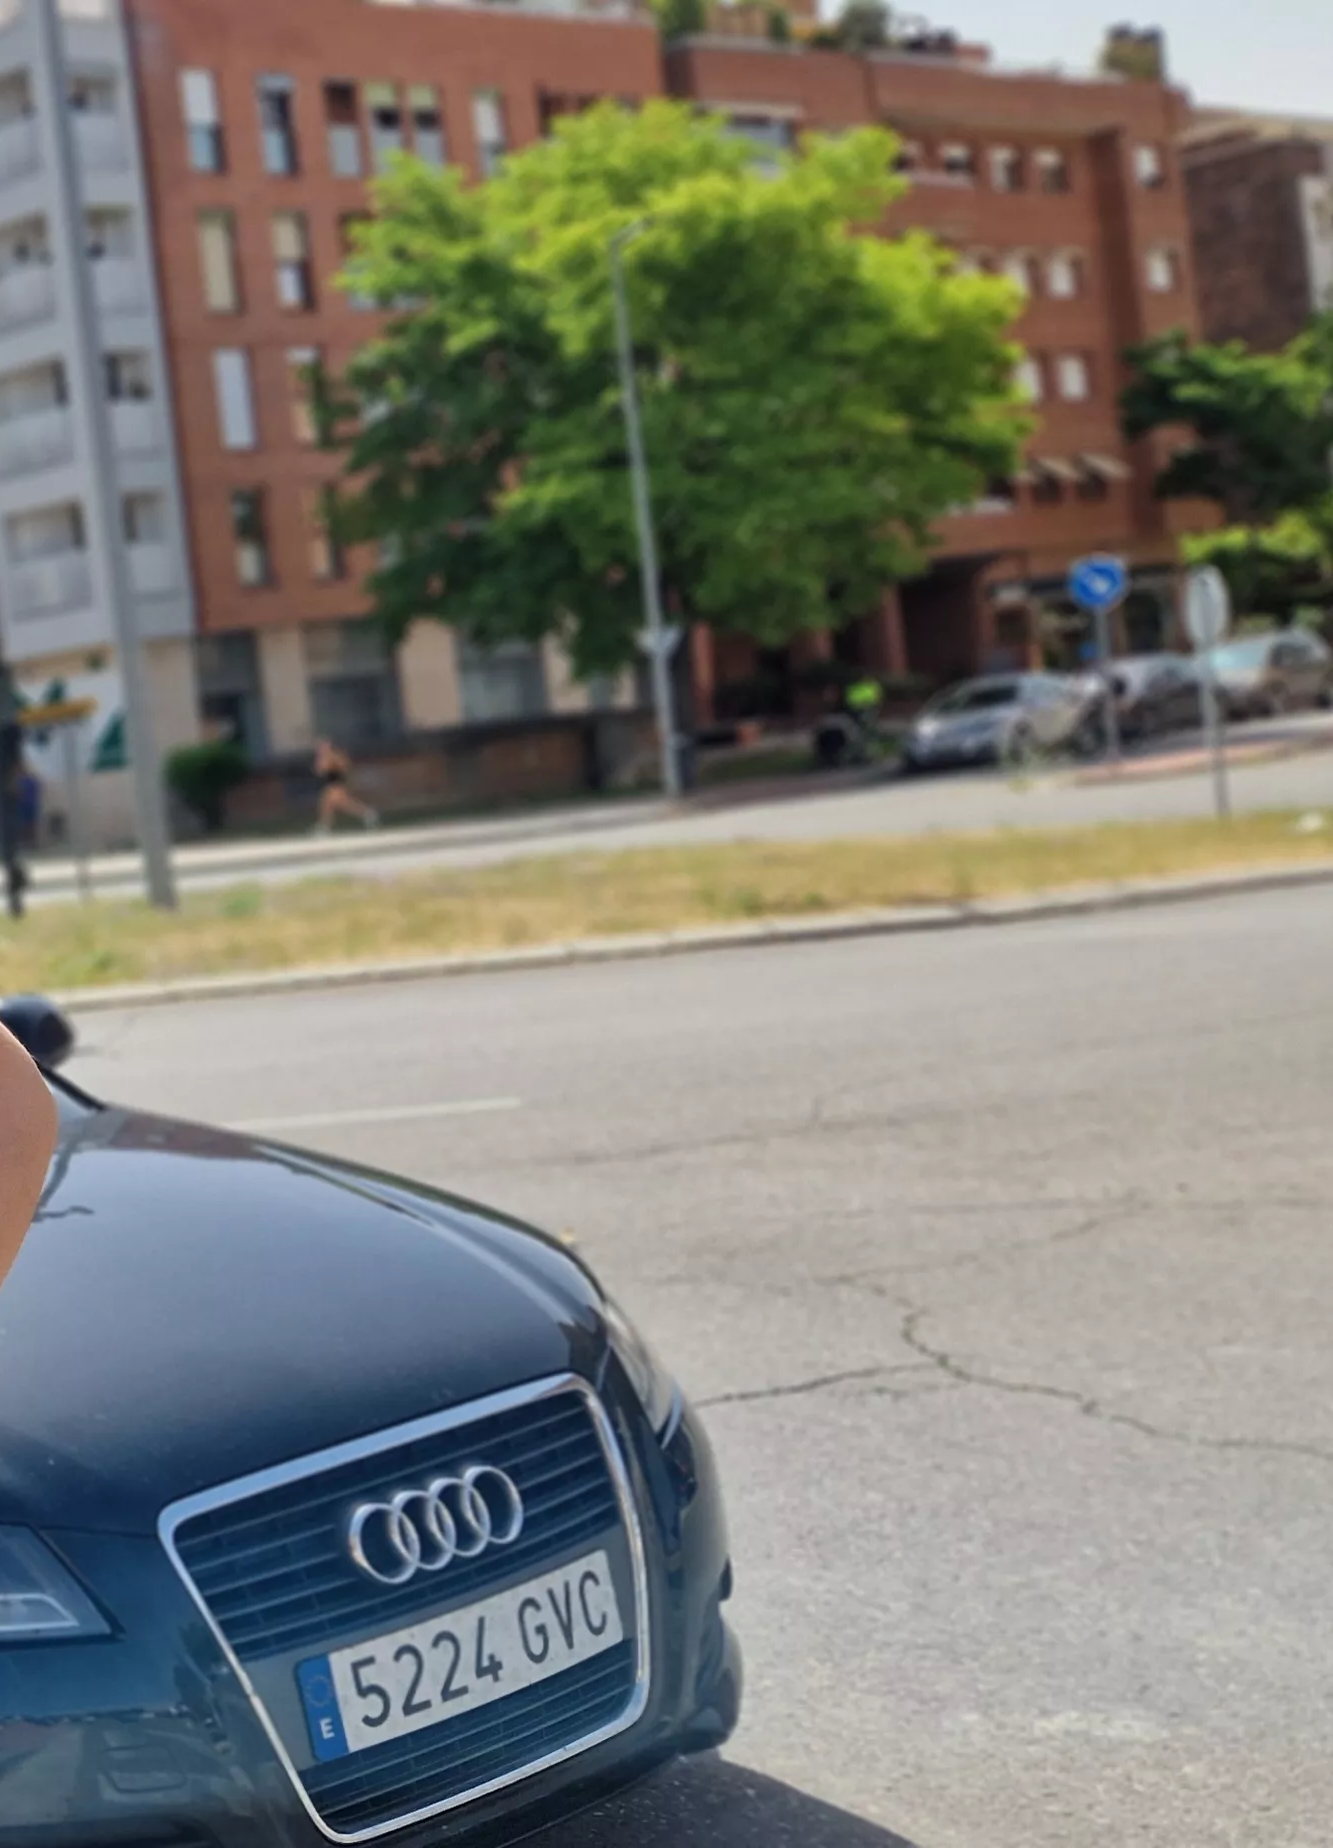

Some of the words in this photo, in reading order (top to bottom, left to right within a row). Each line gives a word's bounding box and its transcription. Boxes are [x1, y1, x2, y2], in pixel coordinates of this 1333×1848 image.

[350, 1615, 504, 1728] 5224
[517, 1569, 608, 1665] GVC
[319, 1717, 335, 1740] E
